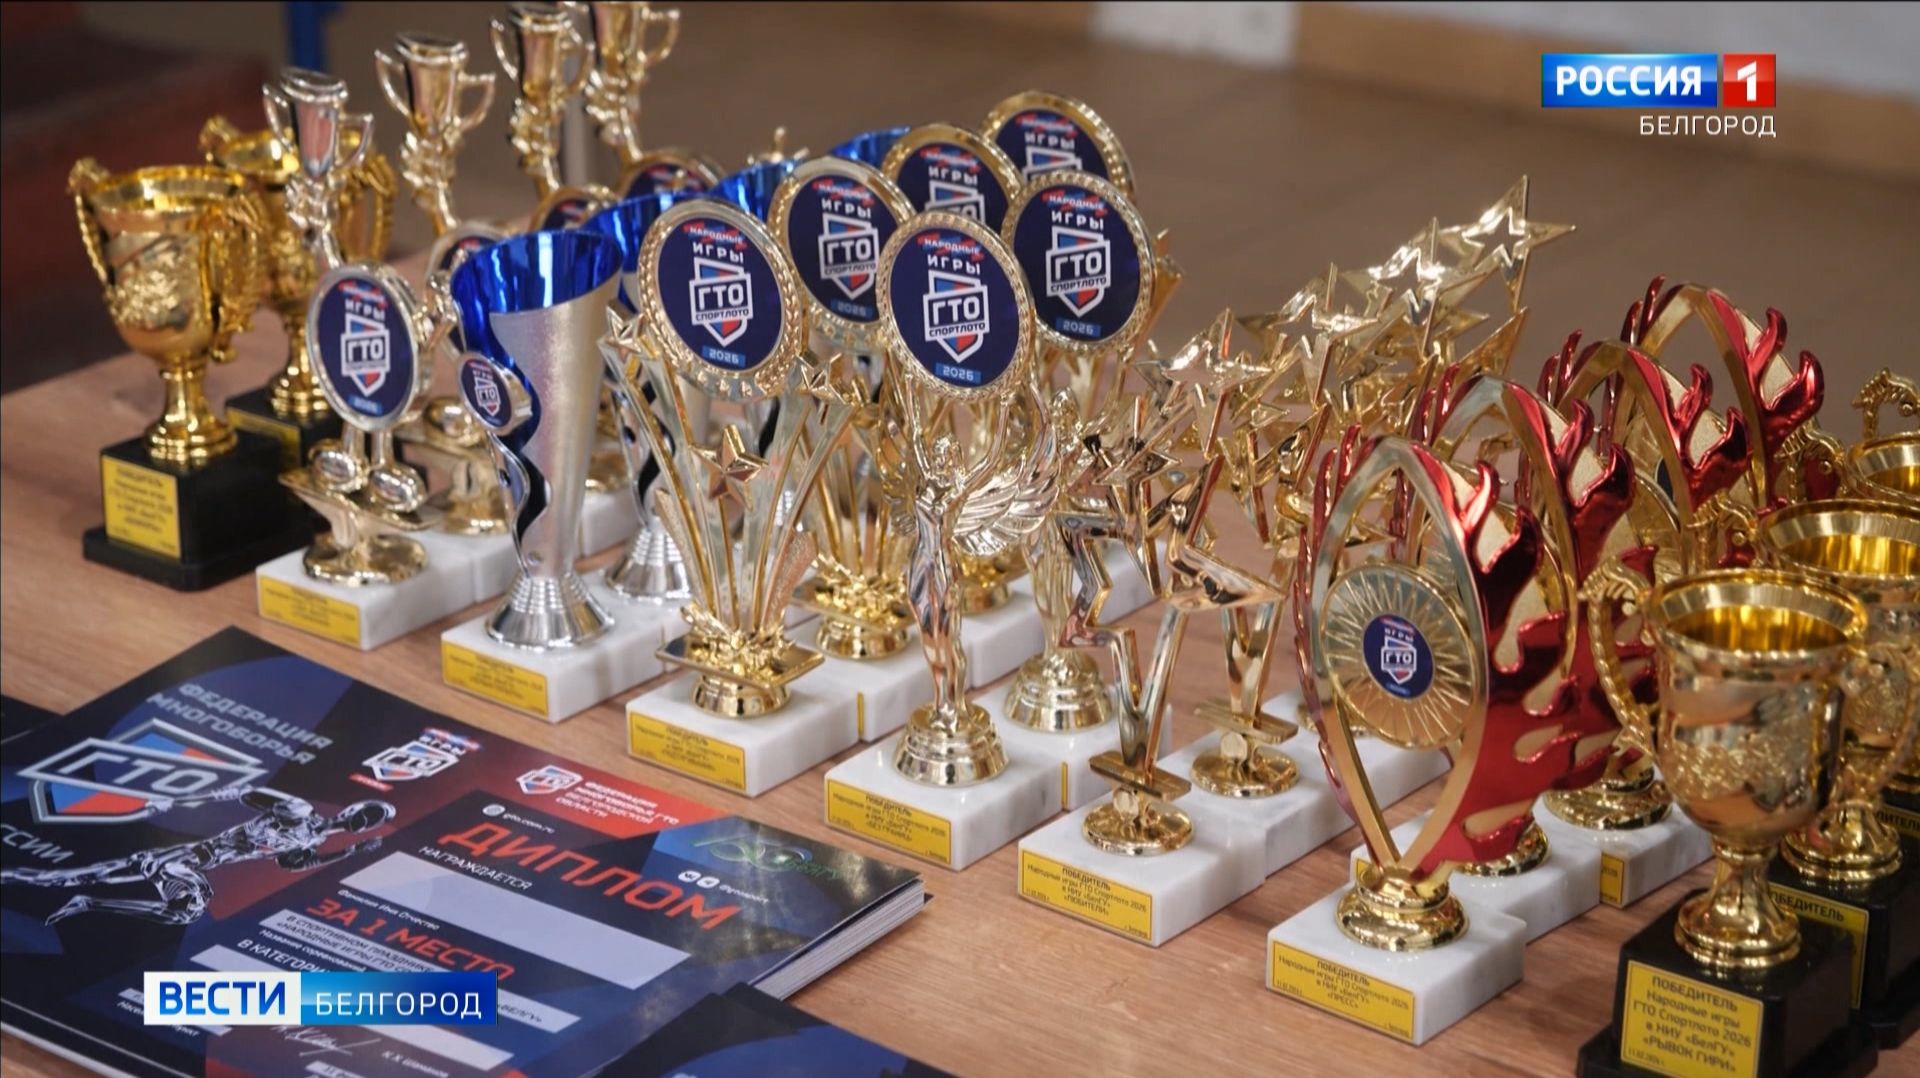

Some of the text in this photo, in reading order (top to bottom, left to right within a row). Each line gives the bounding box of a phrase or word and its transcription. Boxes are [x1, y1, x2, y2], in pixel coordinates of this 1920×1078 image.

[821, 199, 871, 219] ИГРЫ
[1051, 210, 1104, 230] ИГРЫ
[692, 242, 744, 263] ИГРЫ
[827, 237, 872, 264] ГТО
[924, 238, 980, 255] НАРОДНЫЕ
[927, 254, 981, 275] ИГРЫ
[1055, 251, 1102, 280] ГТО
[698, 283, 744, 310] ГТО
[1050, 276, 1107, 293] СПОРТЛОТО
[695, 308, 750, 322] СПОРТЛОТО
[932, 297, 980, 325] ГТО
[929, 322, 985, 337] СПОРТЛОТО
[348, 338, 383, 361] ГТО
[943, 365, 974, 381] 2026
[146, 691, 317, 765] МНОГОБОРЬЯ
[178, 682, 333, 750] ФЕДЕРАЦИЯ
[57, 751, 219, 795] ГТО
[418, 845, 533, 891] НАГРАЖДАЕТСЯ
[438, 821, 742, 931] ДИПЛОМ
[1062, 868, 1111, 891] ПОБЕДИТЕЛЬ
[237, 938, 252, 949] В
[305, 898, 515, 981] ЗА 1 МЕСТО
[1317, 960, 1370, 985] ПОБЕДИТЕЛЬ
[1652, 975, 1738, 1012] ПОБЕДИТЕЛЬ
[1647, 990, 1740, 1028] Народные игры
[1633, 1000, 1751, 1047] ГТО Спортлото 2026
[1646, 1022, 1735, 1057] в НИУ «БелГУ»
[1643, 1035, 1736, 1072] «РЫВОК ГИРИ»
